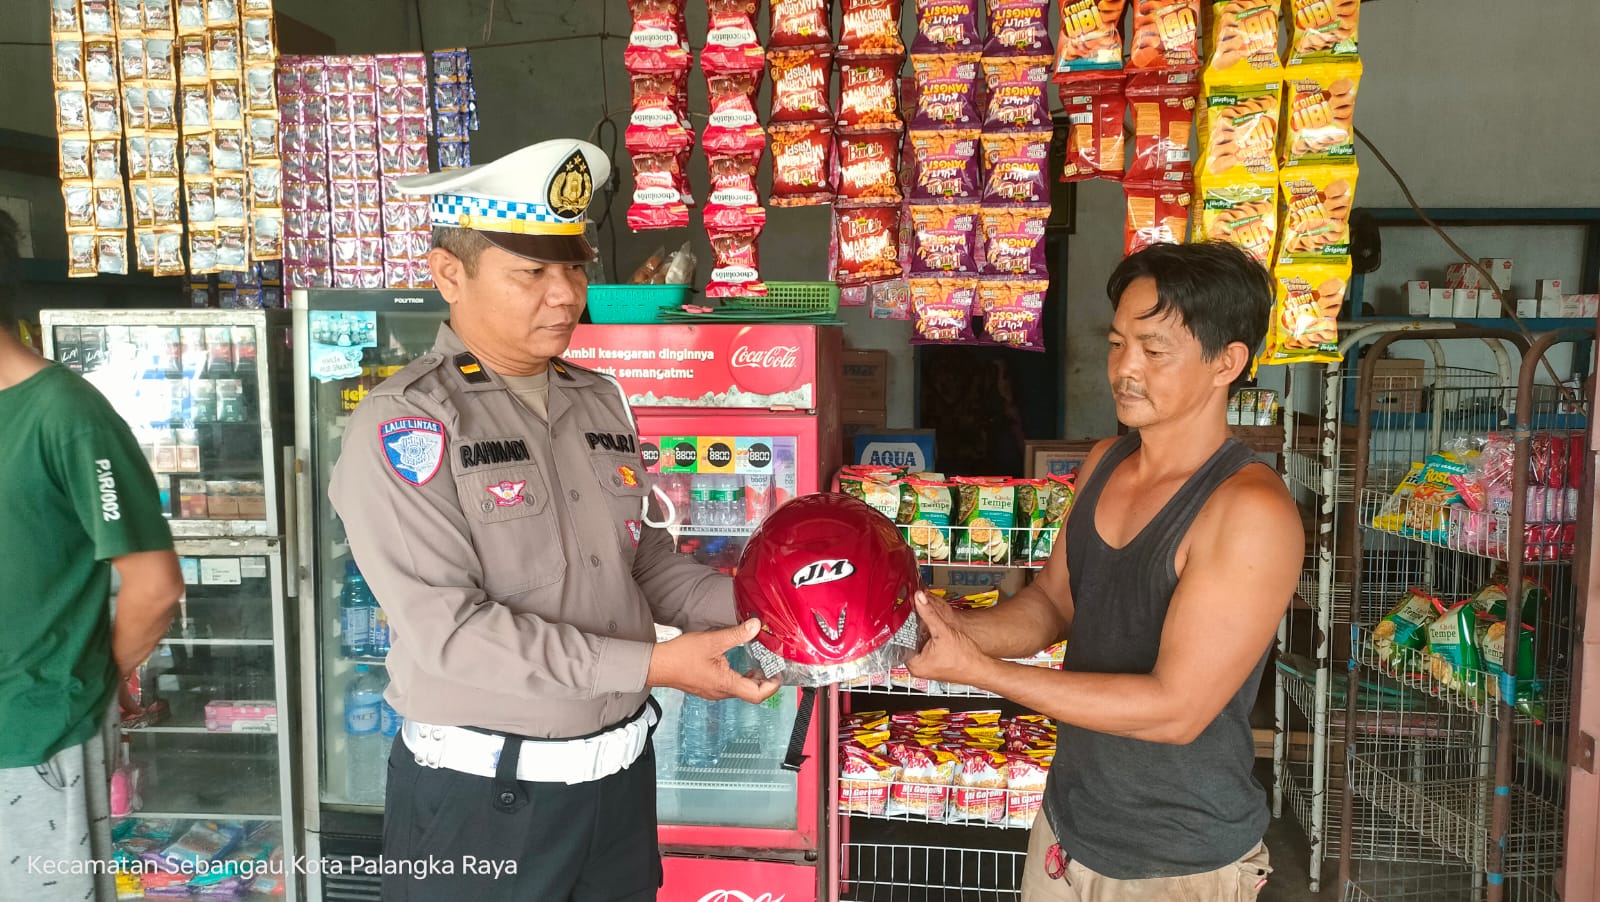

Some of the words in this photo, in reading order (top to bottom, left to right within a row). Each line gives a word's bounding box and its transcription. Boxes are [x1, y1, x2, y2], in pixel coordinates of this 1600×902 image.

[843, 5, 891, 30] MAKARONI
[922, 5, 970, 18] PANGSIT
[994, 7, 1042, 20] PANGSIT
[1296, 0, 1336, 30] UBI
[933, 15, 959, 25] KULIT
[1004, 17, 1031, 27] KULIT
[1064, 5, 1100, 38] UBI
[1156, 8, 1196, 43] UBI
[922, 82, 969, 95] PANGSIT
[995, 85, 1041, 96] PANGSIT
[932, 92, 958, 102] KULIT
[1212, 96, 1236, 106] Original
[1293, 92, 1325, 111] KRISPI
[1293, 100, 1333, 130] UBI
[785, 138, 811, 156] KRISPI
[1330, 145, 1353, 155] Original
[931, 169, 957, 178] KULIT
[994, 162, 1040, 172] PANGSIT
[1209, 199, 1233, 209] Original
[1289, 194, 1319, 210] KRISPI
[930, 244, 956, 253] KULIT
[1324, 244, 1349, 254] Original
[997, 320, 1024, 331] KULIT
[562, 348, 596, 360] Ambil
[598, 348, 656, 361] kesegaran
[659, 348, 714, 361] dinginnya
[731, 345, 800, 369] Coca-Cola
[384, 420, 409, 434] LALU
[408, 420, 438, 432] LINTAS
[585, 432, 636, 454] POLRI
[459, 439, 530, 468] RAHMADI
[675, 449, 696, 460] 8800
[709, 450, 730, 461] 8800
[749, 450, 770, 461] 8800
[869, 450, 917, 467] AQUA
[921, 502, 950, 511] Tempe
[981, 497, 1012, 509] Tempe
[798, 560, 847, 585] JM
[1402, 606, 1424, 620] Tempe
[1430, 628, 1456, 641] Tempe
[1483, 644, 1505, 658] Temp
[965, 791, 976, 800] Mi
[1010, 796, 1020, 805] Mi
